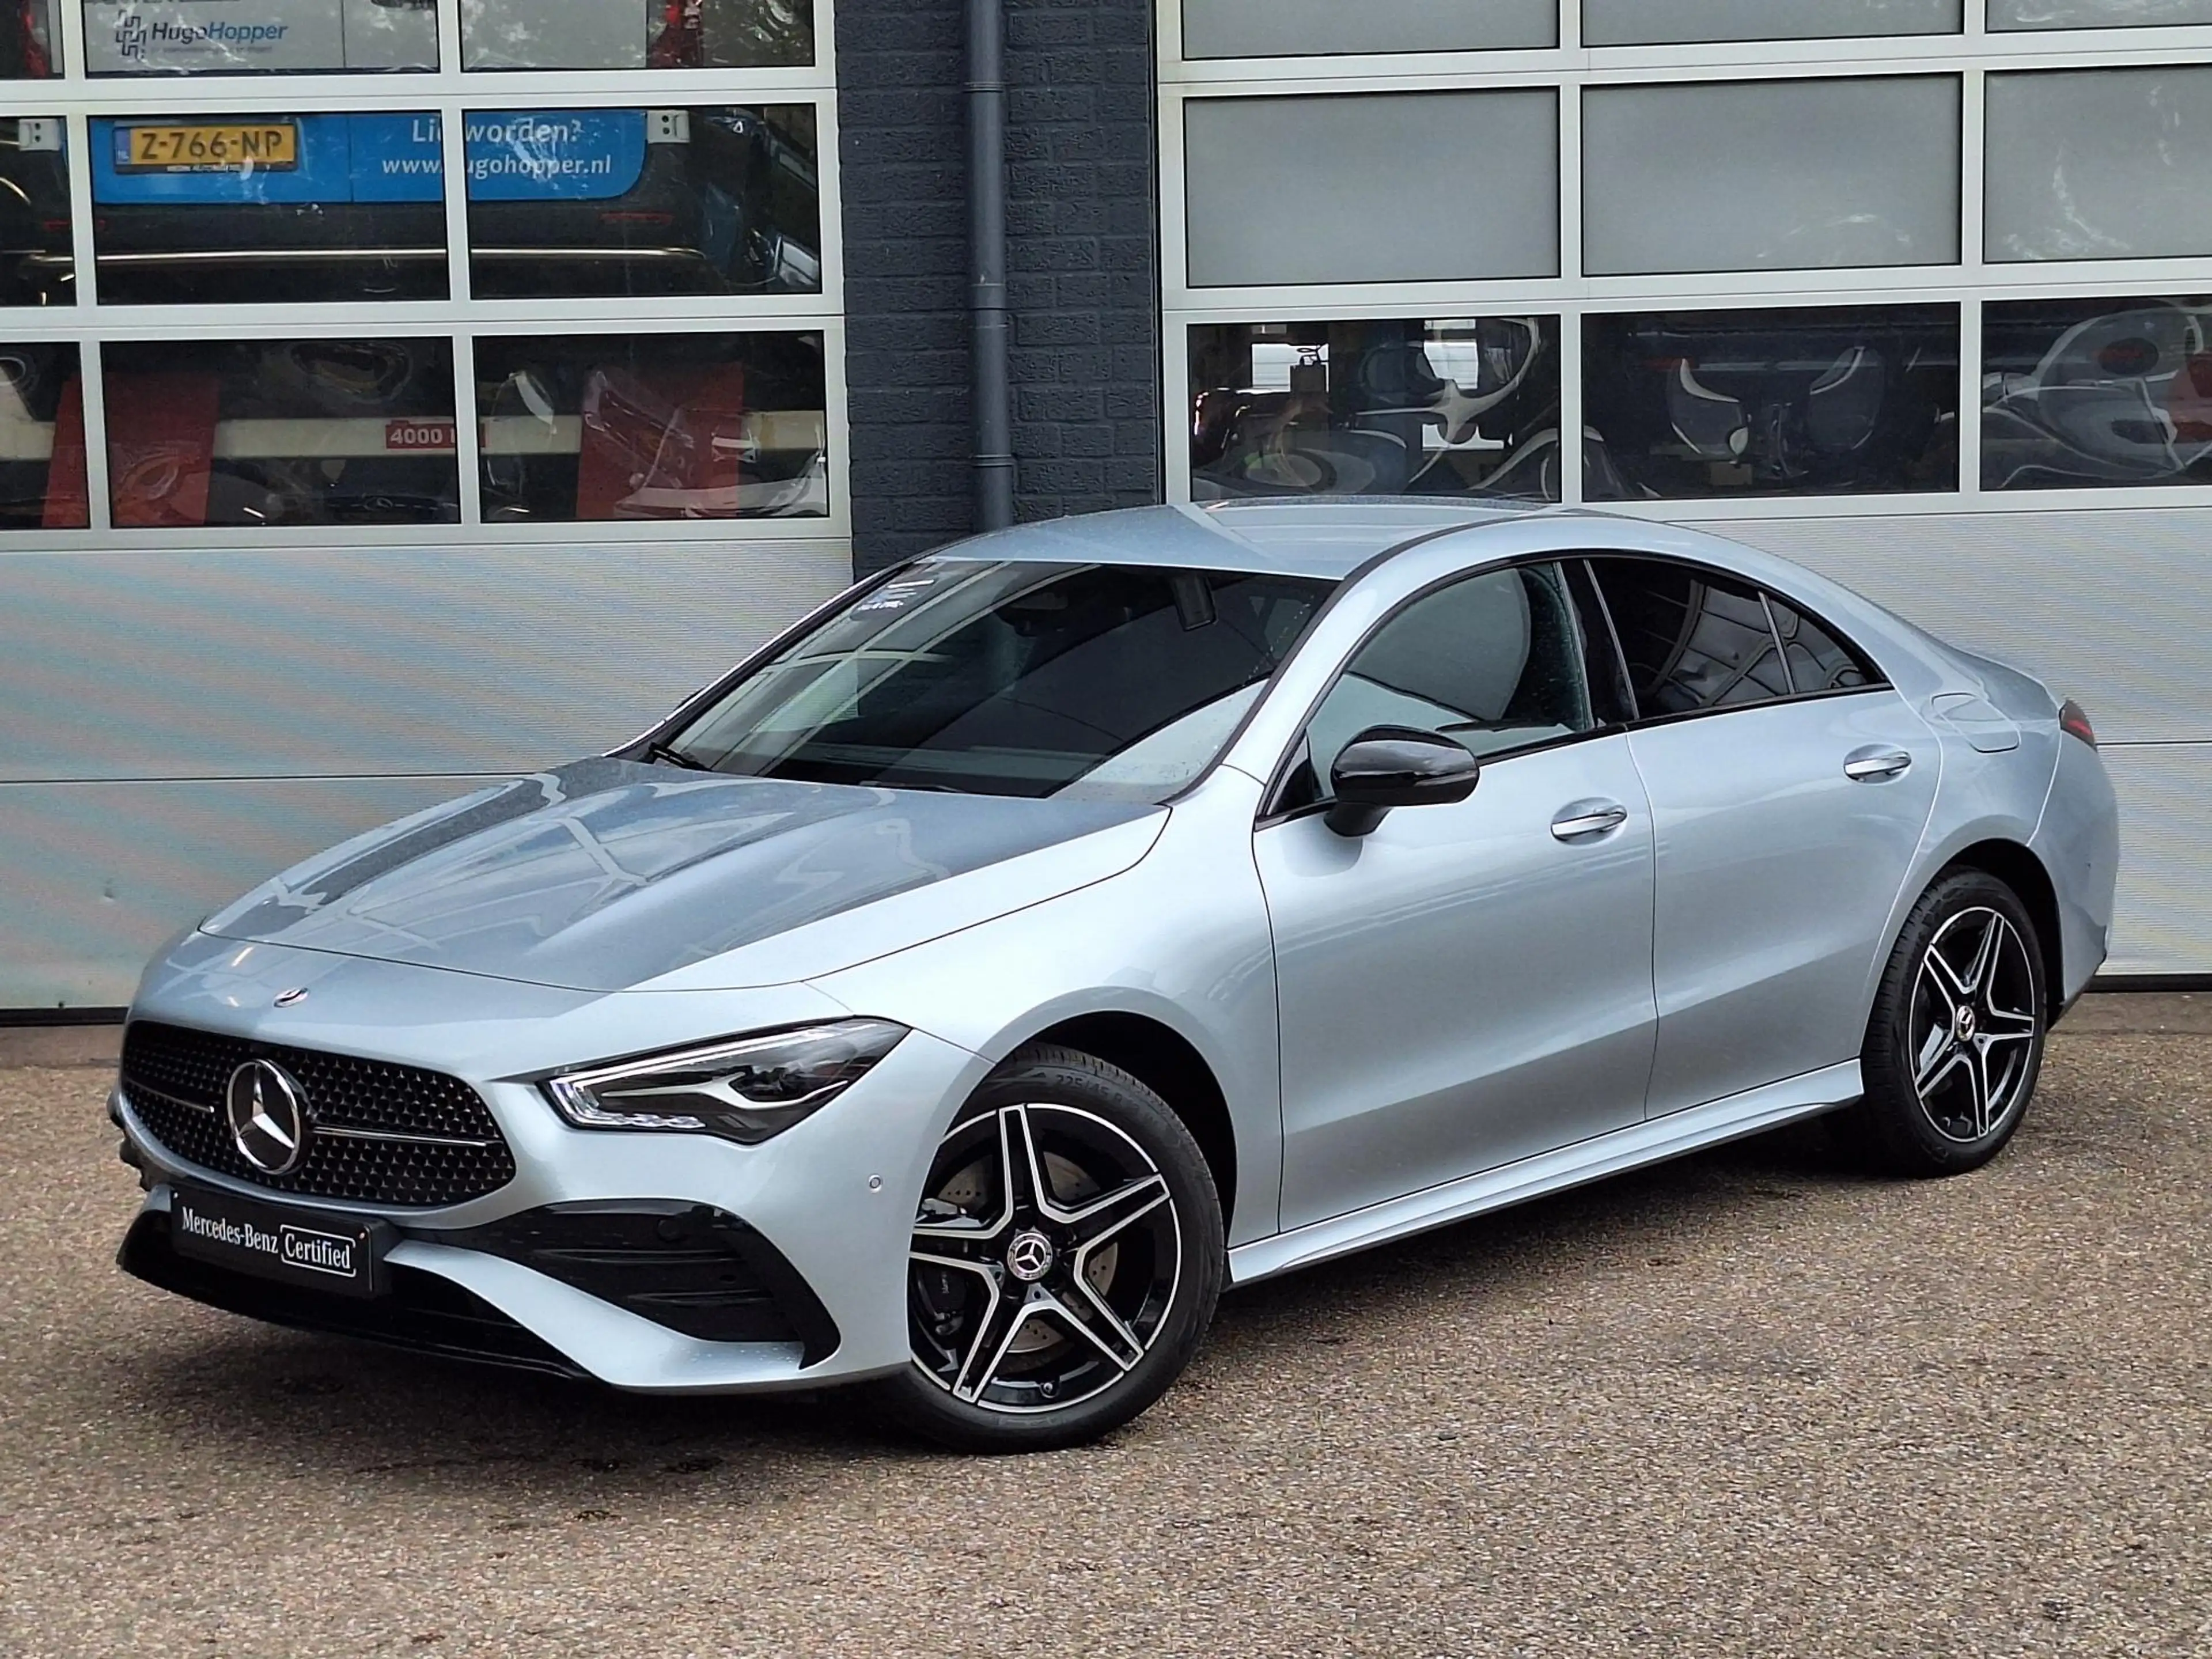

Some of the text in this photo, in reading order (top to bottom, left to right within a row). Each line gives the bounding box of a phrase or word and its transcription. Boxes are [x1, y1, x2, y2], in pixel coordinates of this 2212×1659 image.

[152, 22, 288, 44] HugoHopper
[412, 118, 441, 142] Li
[141, 131, 282, 160] Z-766-NP
[382, 154, 611, 180] www.ugohopper.nl
[391, 427, 443, 444] 4000
[181, 1206, 351, 1269] Mercedes-Benz Certified
